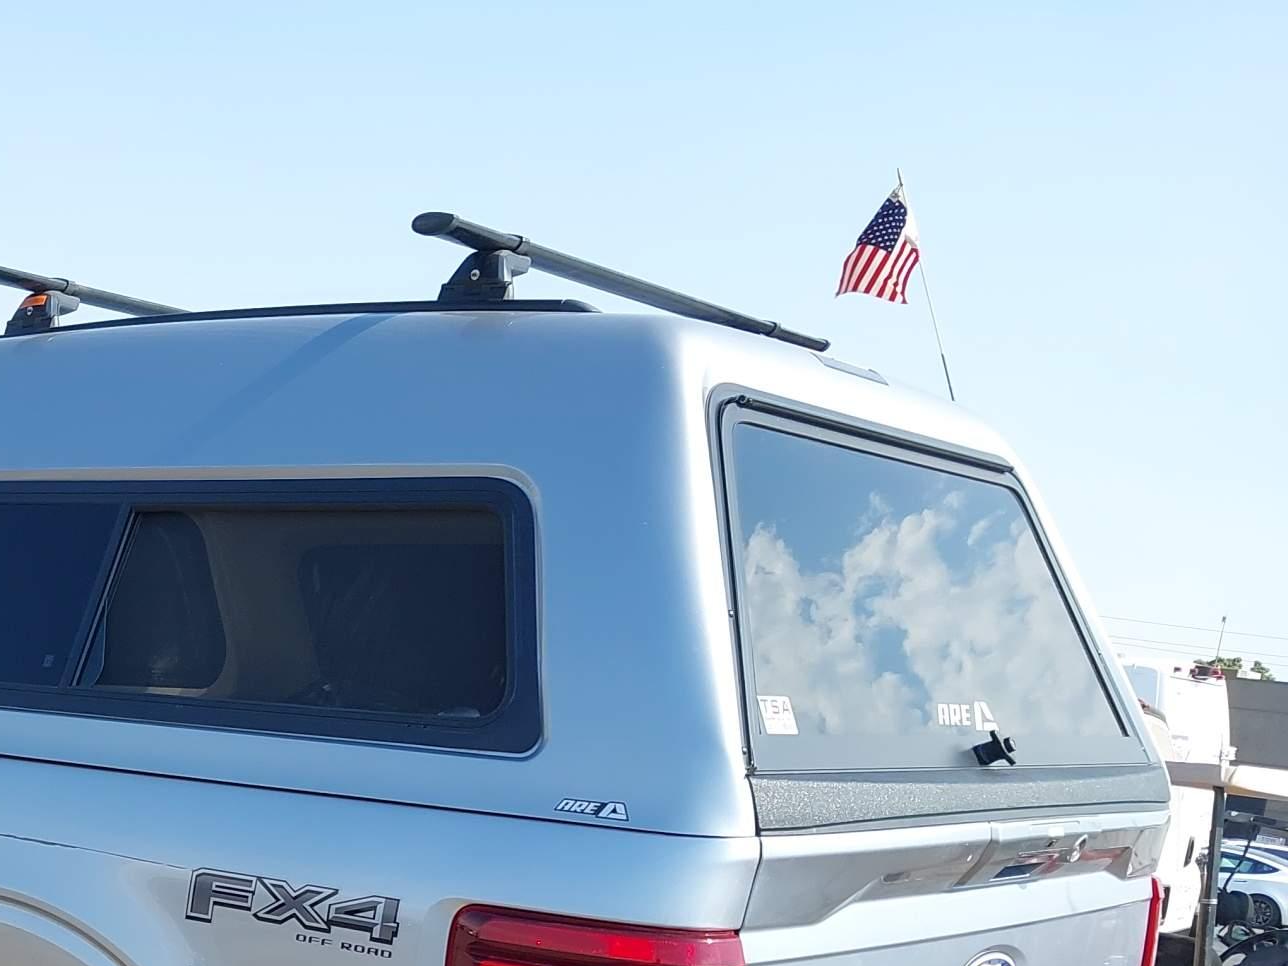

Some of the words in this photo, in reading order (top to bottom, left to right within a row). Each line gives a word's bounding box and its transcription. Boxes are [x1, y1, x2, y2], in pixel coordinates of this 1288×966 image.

[760, 699, 790, 715] TSA
[185, 867, 400, 945] FX4
[295, 933, 332, 946] OFF
[340, 942, 393, 959] ROAD
